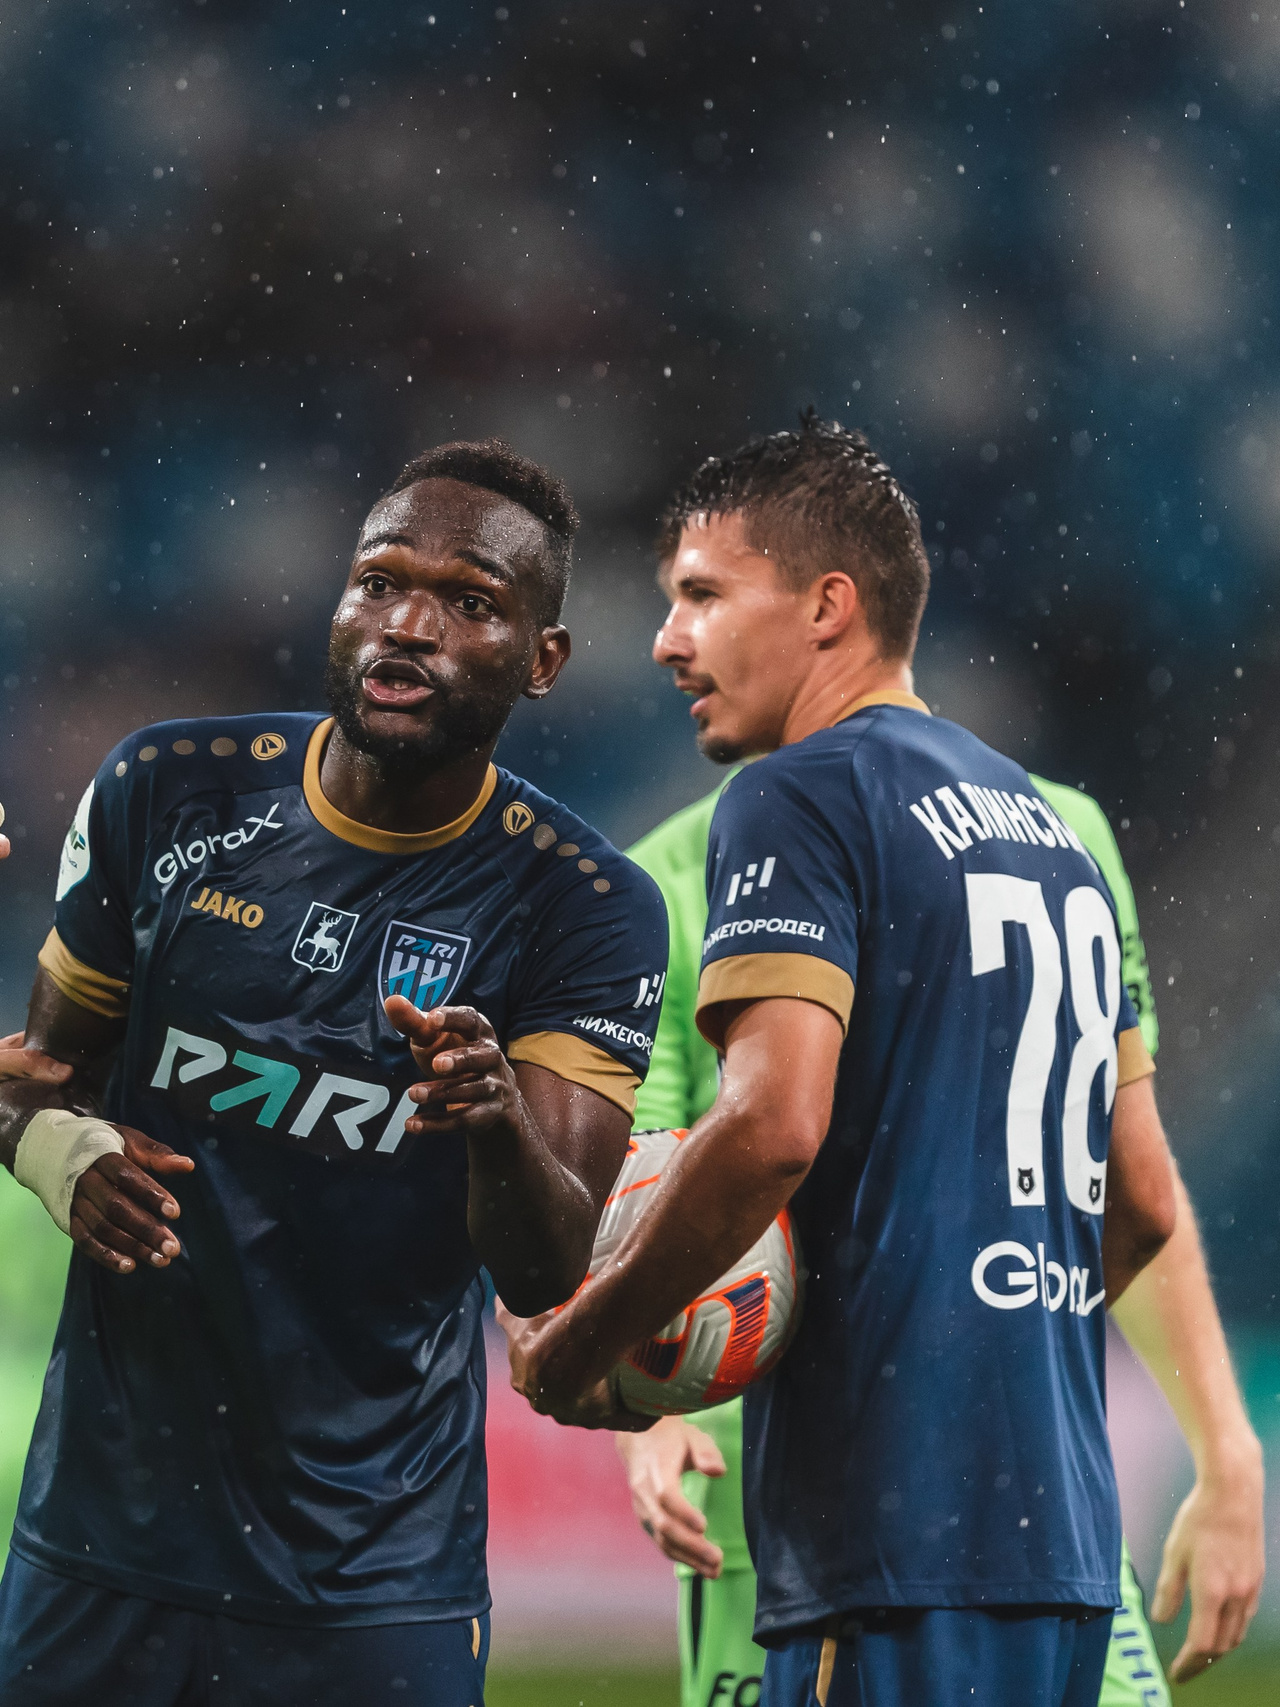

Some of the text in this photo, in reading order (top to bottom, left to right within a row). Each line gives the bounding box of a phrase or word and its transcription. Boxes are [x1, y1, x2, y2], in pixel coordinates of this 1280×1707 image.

[154, 802, 284, 884] GloraX
[909, 781, 1099, 875] КАЛИНСК
[190, 887, 264, 929] JAKO
[395, 933, 458, 959] PARI
[965, 872, 1121, 1215] 78
[150, 1026, 420, 1154] PARI
